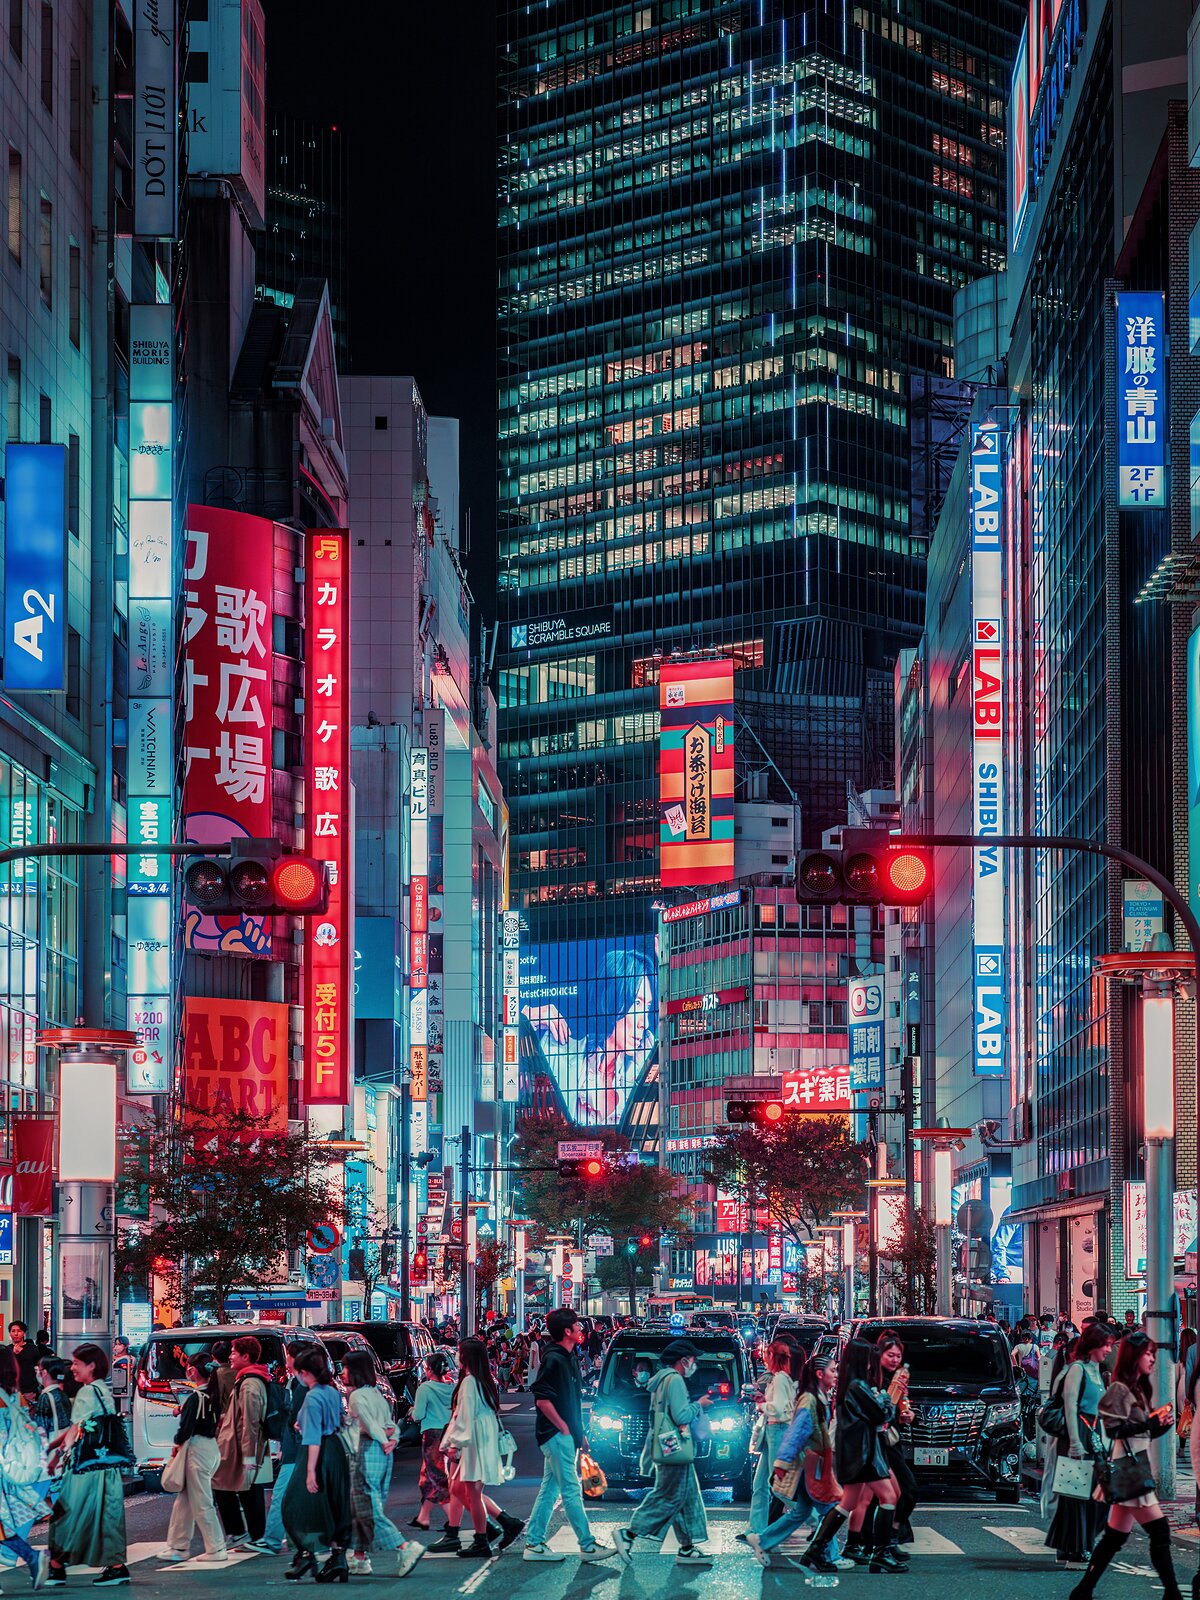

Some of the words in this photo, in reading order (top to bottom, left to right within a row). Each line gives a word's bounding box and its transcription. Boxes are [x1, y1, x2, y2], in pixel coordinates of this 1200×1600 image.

[142, 85, 165, 131] 1101
[142, 139, 165, 196] DOT
[132, 341, 169, 349] SHIBUYA
[132, 349, 169, 357] MORIS
[132, 357, 169, 365] BUILDING
[1125, 316, 1158, 444] 洋服の青山
[1130, 468, 1155, 481] 2F
[975, 464, 999, 544] LABI
[1131, 488, 1155, 501] 1F
[14, 589, 55, 662] A2
[528, 619, 567, 634] SHIBUYA
[528, 628, 574, 645] SCRAMBLE
[575, 622, 611, 638] SQUARE
[215, 585, 266, 804] 歌広場
[974, 649, 1001, 740] LABI
[147, 707, 156, 788] WATCHNIAN
[689, 736, 707, 835] お茶づけ海苔
[139, 801, 158, 877] 宝石場
[505, 938, 518, 947] UP
[852, 987, 880, 1012] OS
[134, 1012, 163, 1024] ¥200
[977, 986, 1002, 1067] LABI
[187, 1013, 277, 1074] ABC
[853, 1027, 880, 1054] 調剤
[853, 1057, 880, 1084] 薬局
[187, 1076, 277, 1117] MART
[785, 1075, 850, 1105] スギ薬局
[16, 1159, 50, 1175] au
